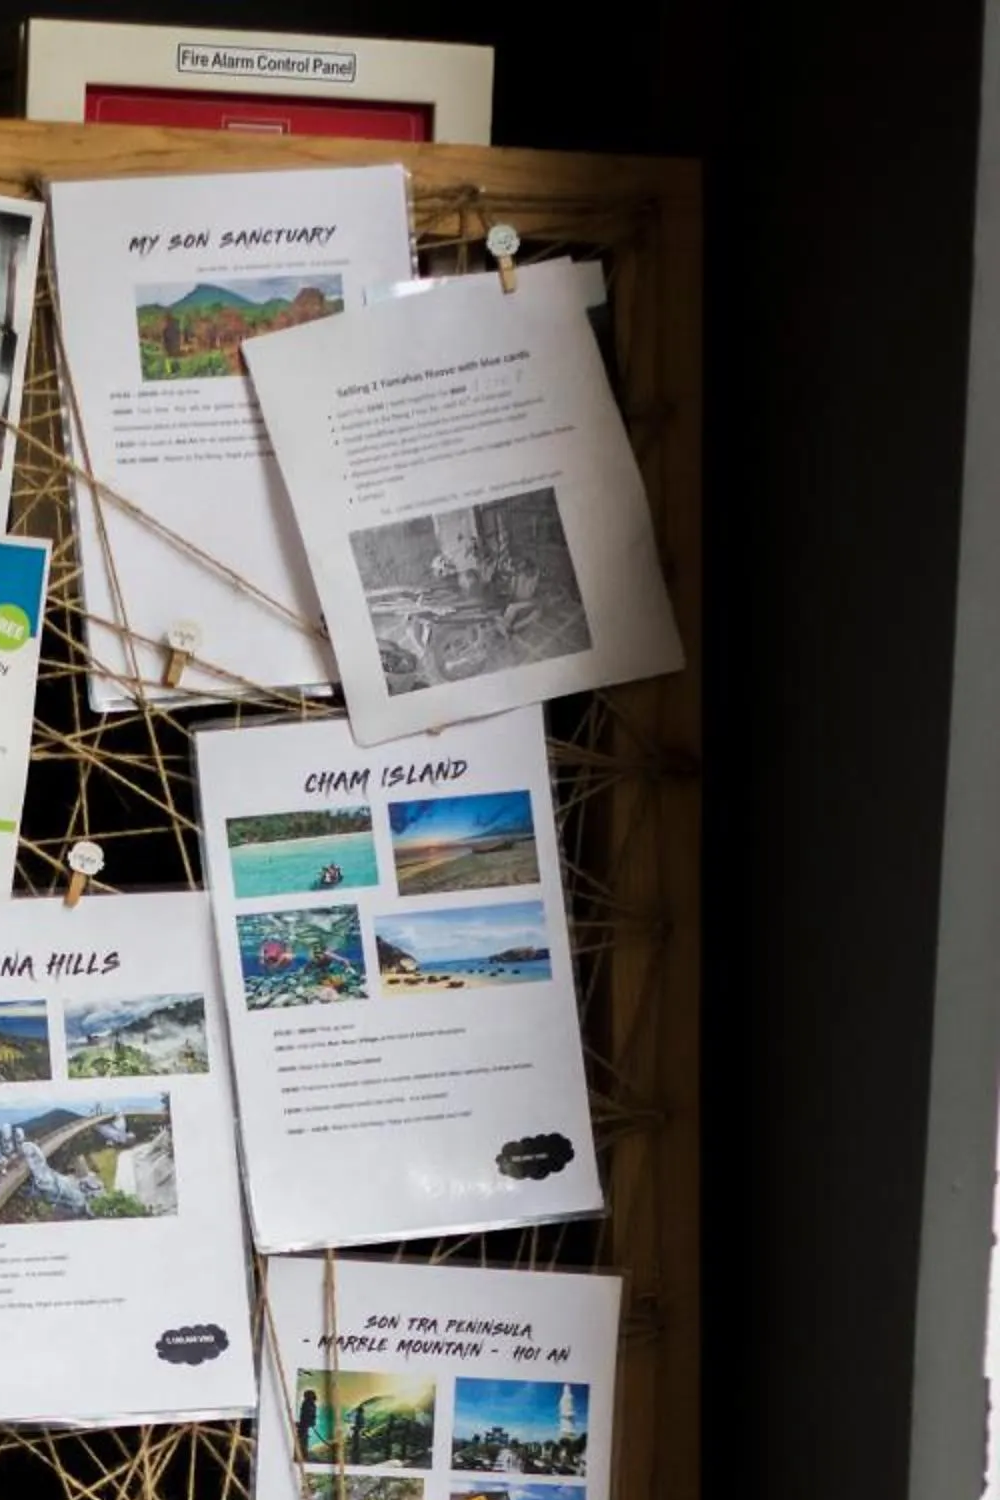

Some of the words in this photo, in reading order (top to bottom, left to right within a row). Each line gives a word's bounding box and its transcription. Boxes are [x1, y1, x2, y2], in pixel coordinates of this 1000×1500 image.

[180, 50, 209, 69] Fire
[211, 53, 254, 72] Alarm
[256, 55, 310, 75] Control
[312, 59, 354, 77] Panel
[129, 234, 161, 259] MY
[167, 230, 210, 252] SON
[218, 225, 336, 251] SANCTUARY
[304, 768, 371, 798] CHAM
[381, 758, 469, 788] ISLAND
[0, 951, 37, 982] NA
[47, 951, 121, 981] HILLS
[364, 1315, 400, 1331] SON
[406, 1317, 438, 1335] TRA
[445, 1319, 534, 1340] PENINSULA
[317, 1335, 388, 1356] MARBLE
[396, 1338, 482, 1361] MOUNTAIN
[511, 1345, 543, 1361] HOI
[547, 1345, 572, 1362] AN
